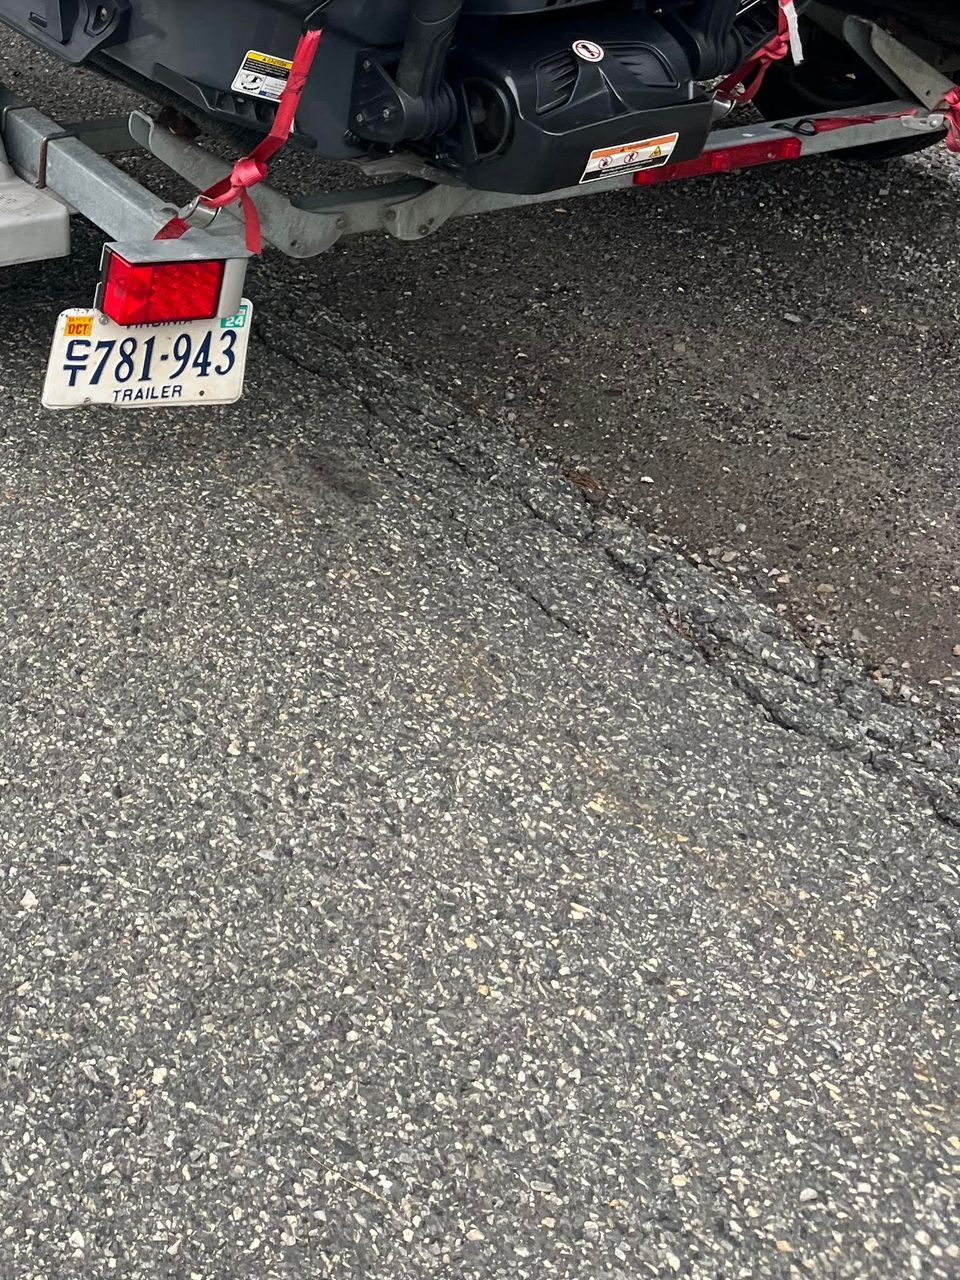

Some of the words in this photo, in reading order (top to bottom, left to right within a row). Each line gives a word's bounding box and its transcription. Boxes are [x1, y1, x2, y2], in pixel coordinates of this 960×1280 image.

[68, 323, 89, 335] OCT
[225, 315, 244, 328] 24
[89, 329, 237, 385] 781-943
[113, 384, 183, 402] TRAILER
